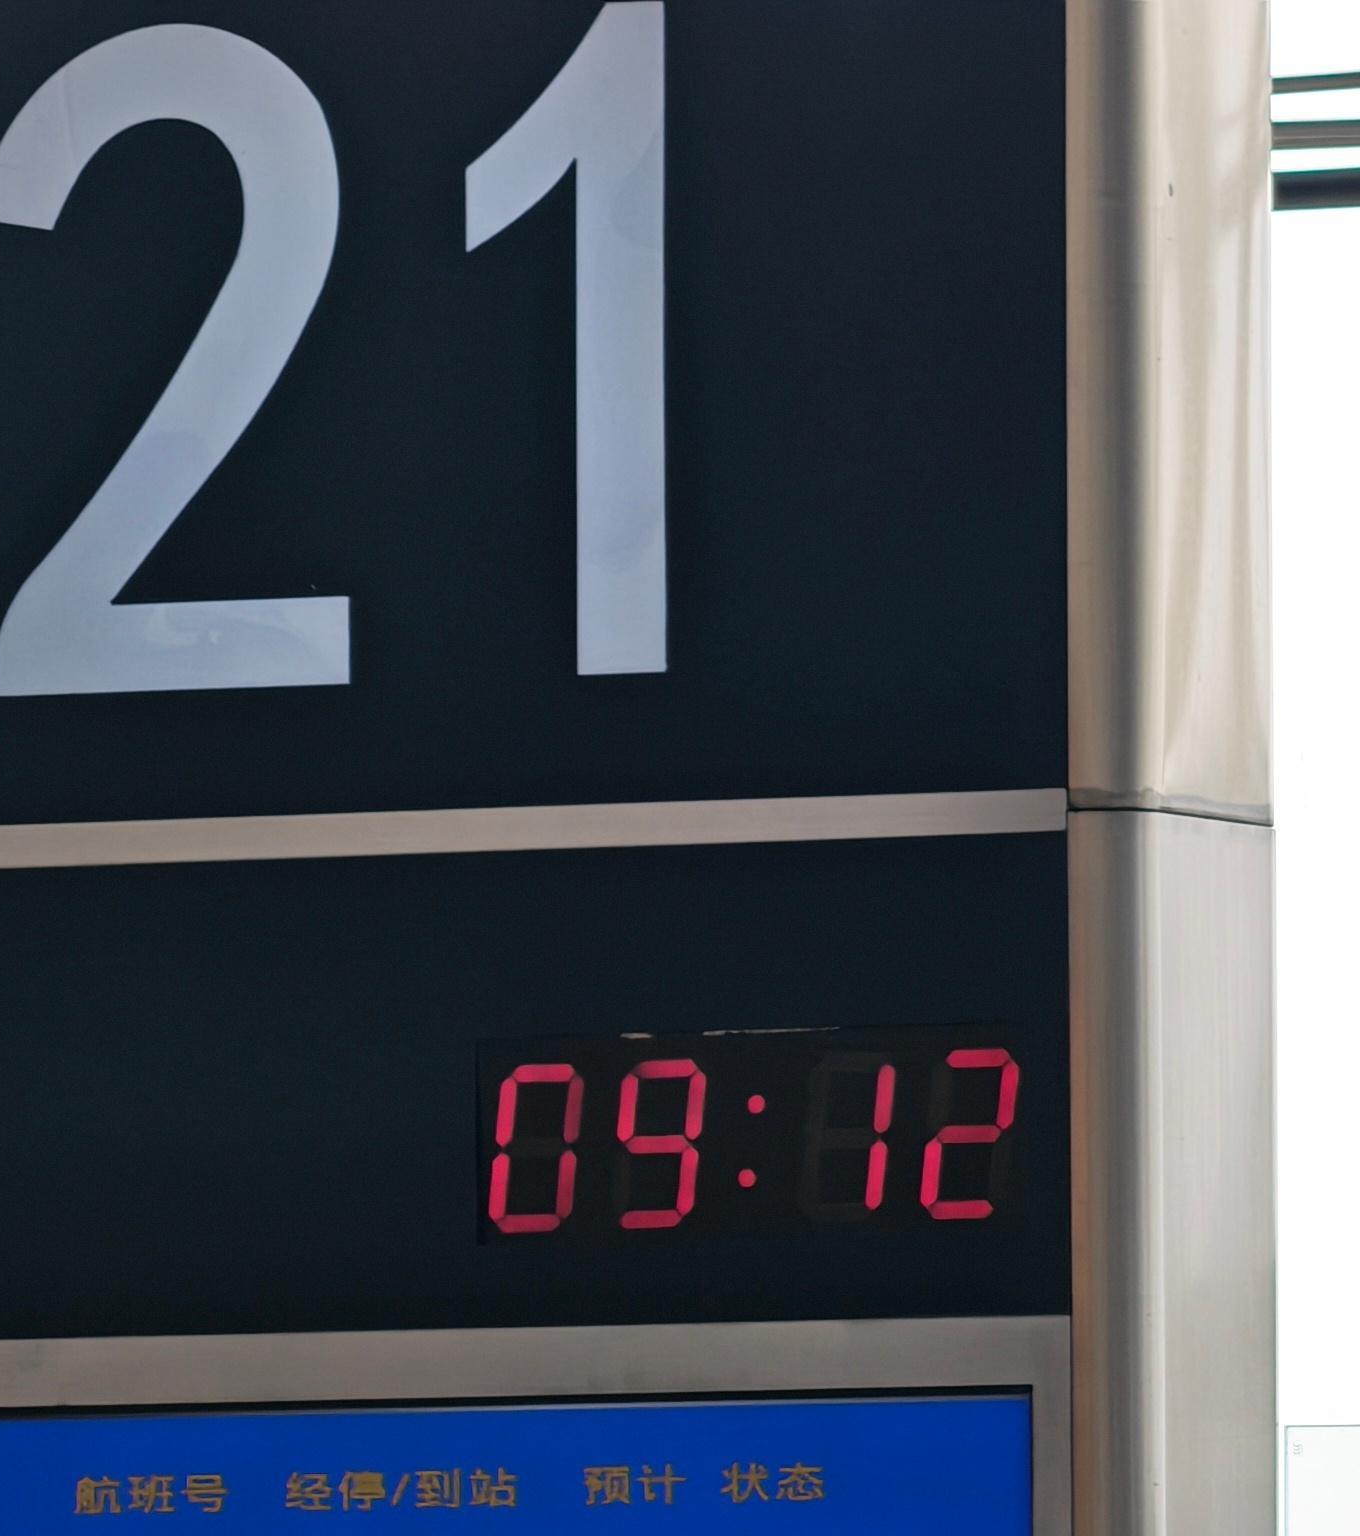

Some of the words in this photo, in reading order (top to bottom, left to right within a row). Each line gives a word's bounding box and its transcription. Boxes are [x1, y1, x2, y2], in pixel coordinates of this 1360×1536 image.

[488, 1048, 1019, 1233] 09:12
[74, 1474, 228, 1515] 航班号
[285, 1467, 517, 1511] 经停/到站
[583, 1463, 686, 1506] 预计
[721, 1462, 825, 1503] 状态
